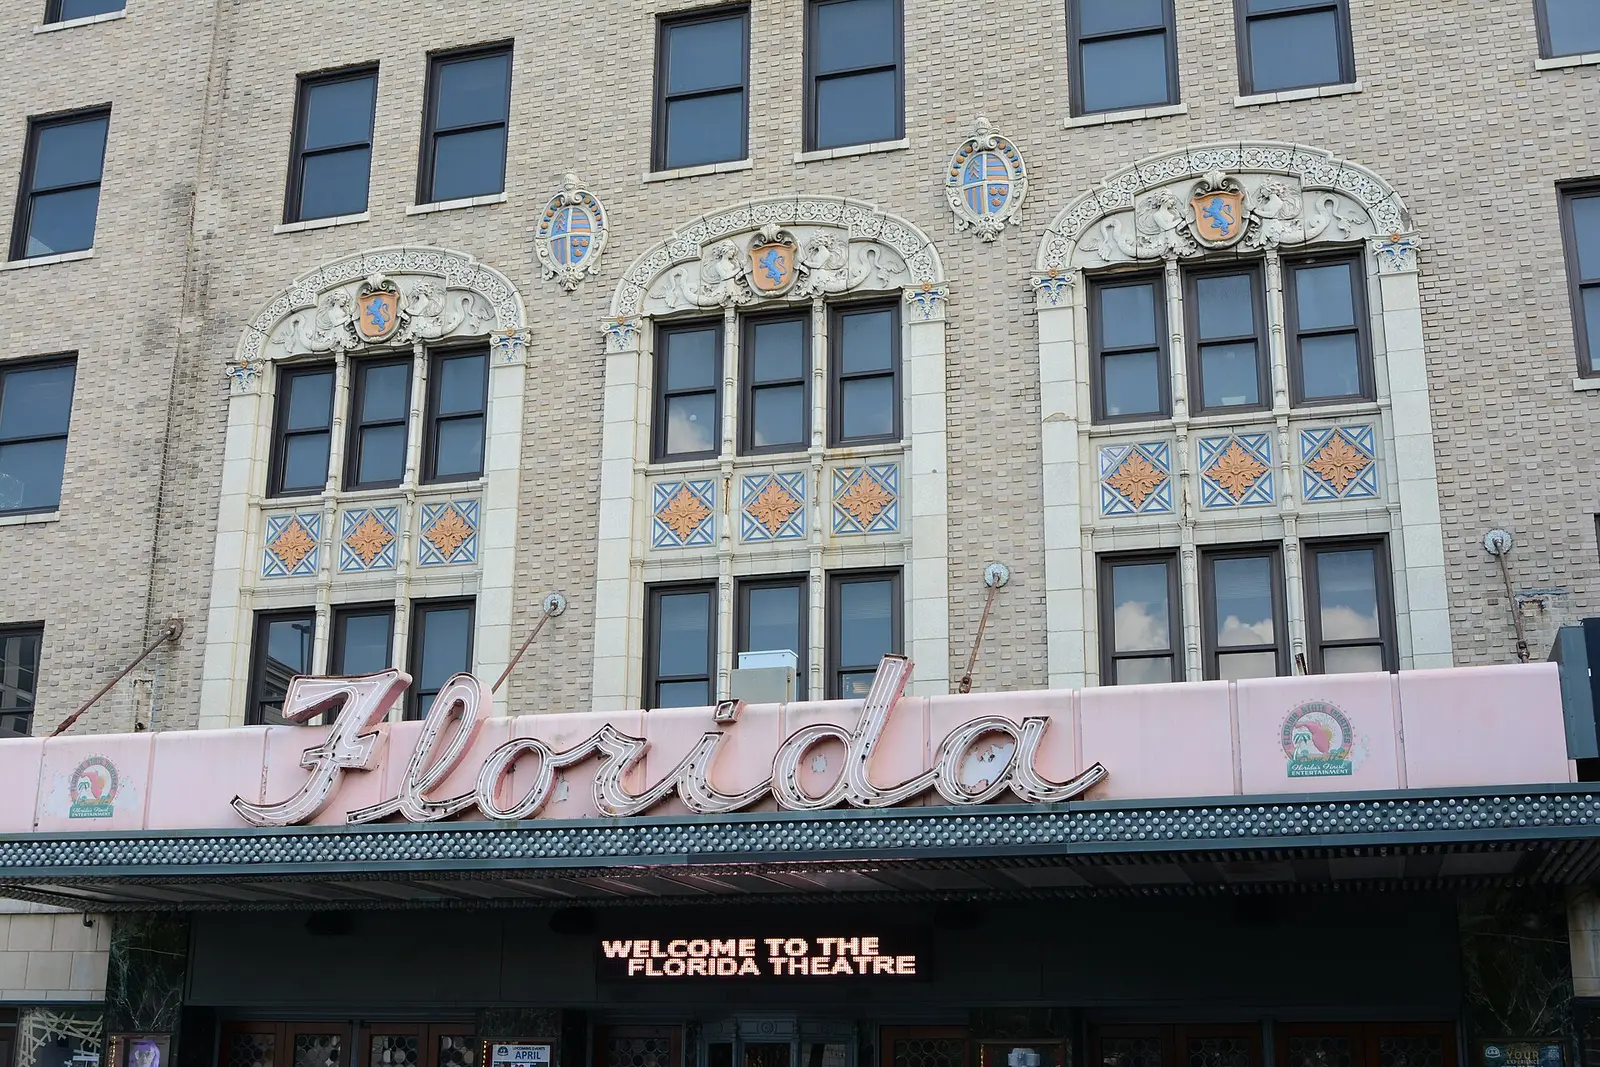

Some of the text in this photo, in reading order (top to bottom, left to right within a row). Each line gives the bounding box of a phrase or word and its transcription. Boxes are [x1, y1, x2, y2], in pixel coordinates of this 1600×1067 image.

[1283, 711, 1298, 746] FLORIDA
[1300, 703, 1327, 714] STATE
[231, 653, 1109, 827] Florida
[602, 937, 879, 958] WELCOME TO THE
[627, 955, 916, 976] FLORIDA THEATRE
[515, 1051, 541, 1060] APRIL
[1506, 1050, 1540, 1060] YOUR
